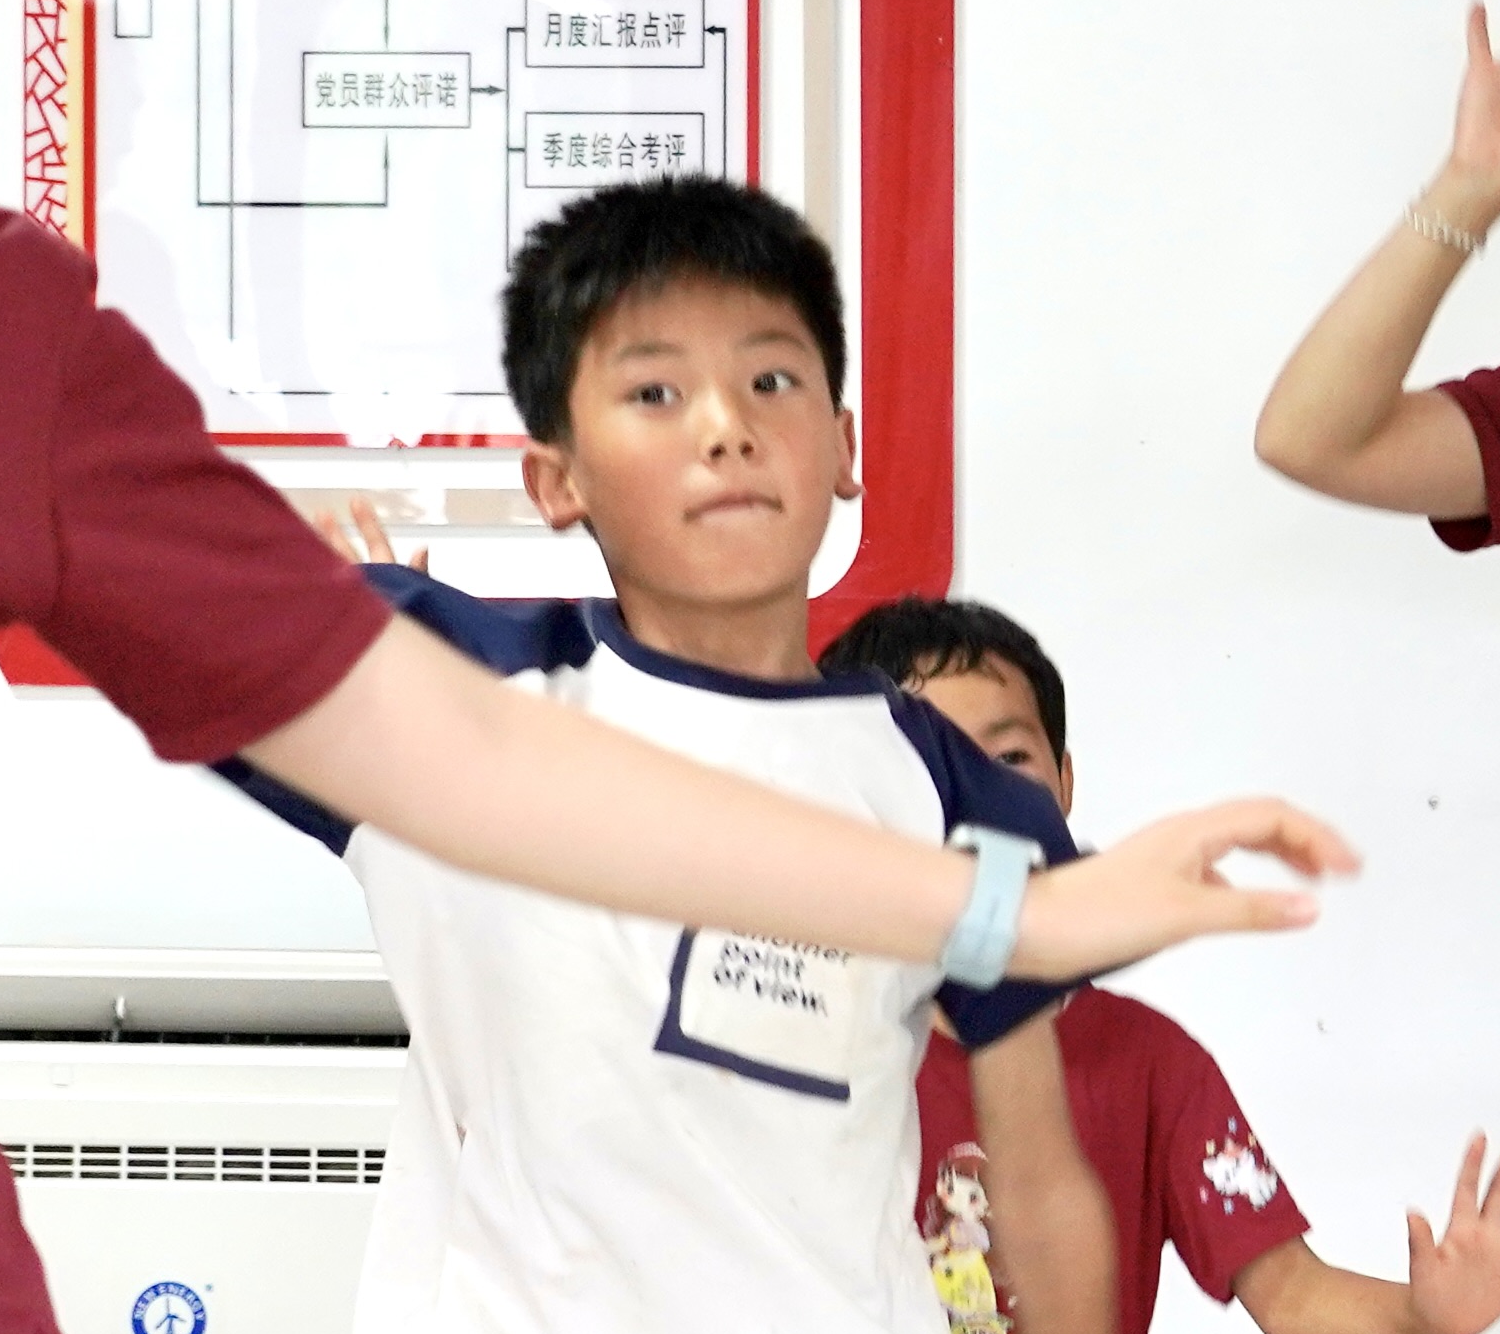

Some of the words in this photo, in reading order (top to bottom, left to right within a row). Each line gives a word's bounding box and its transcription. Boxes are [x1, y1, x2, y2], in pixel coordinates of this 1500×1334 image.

[545, 13, 686, 47] 月度汇报点评
[317, 74, 457, 107] 党员群众评诺
[544, 133, 685, 169] 季度综合考评
